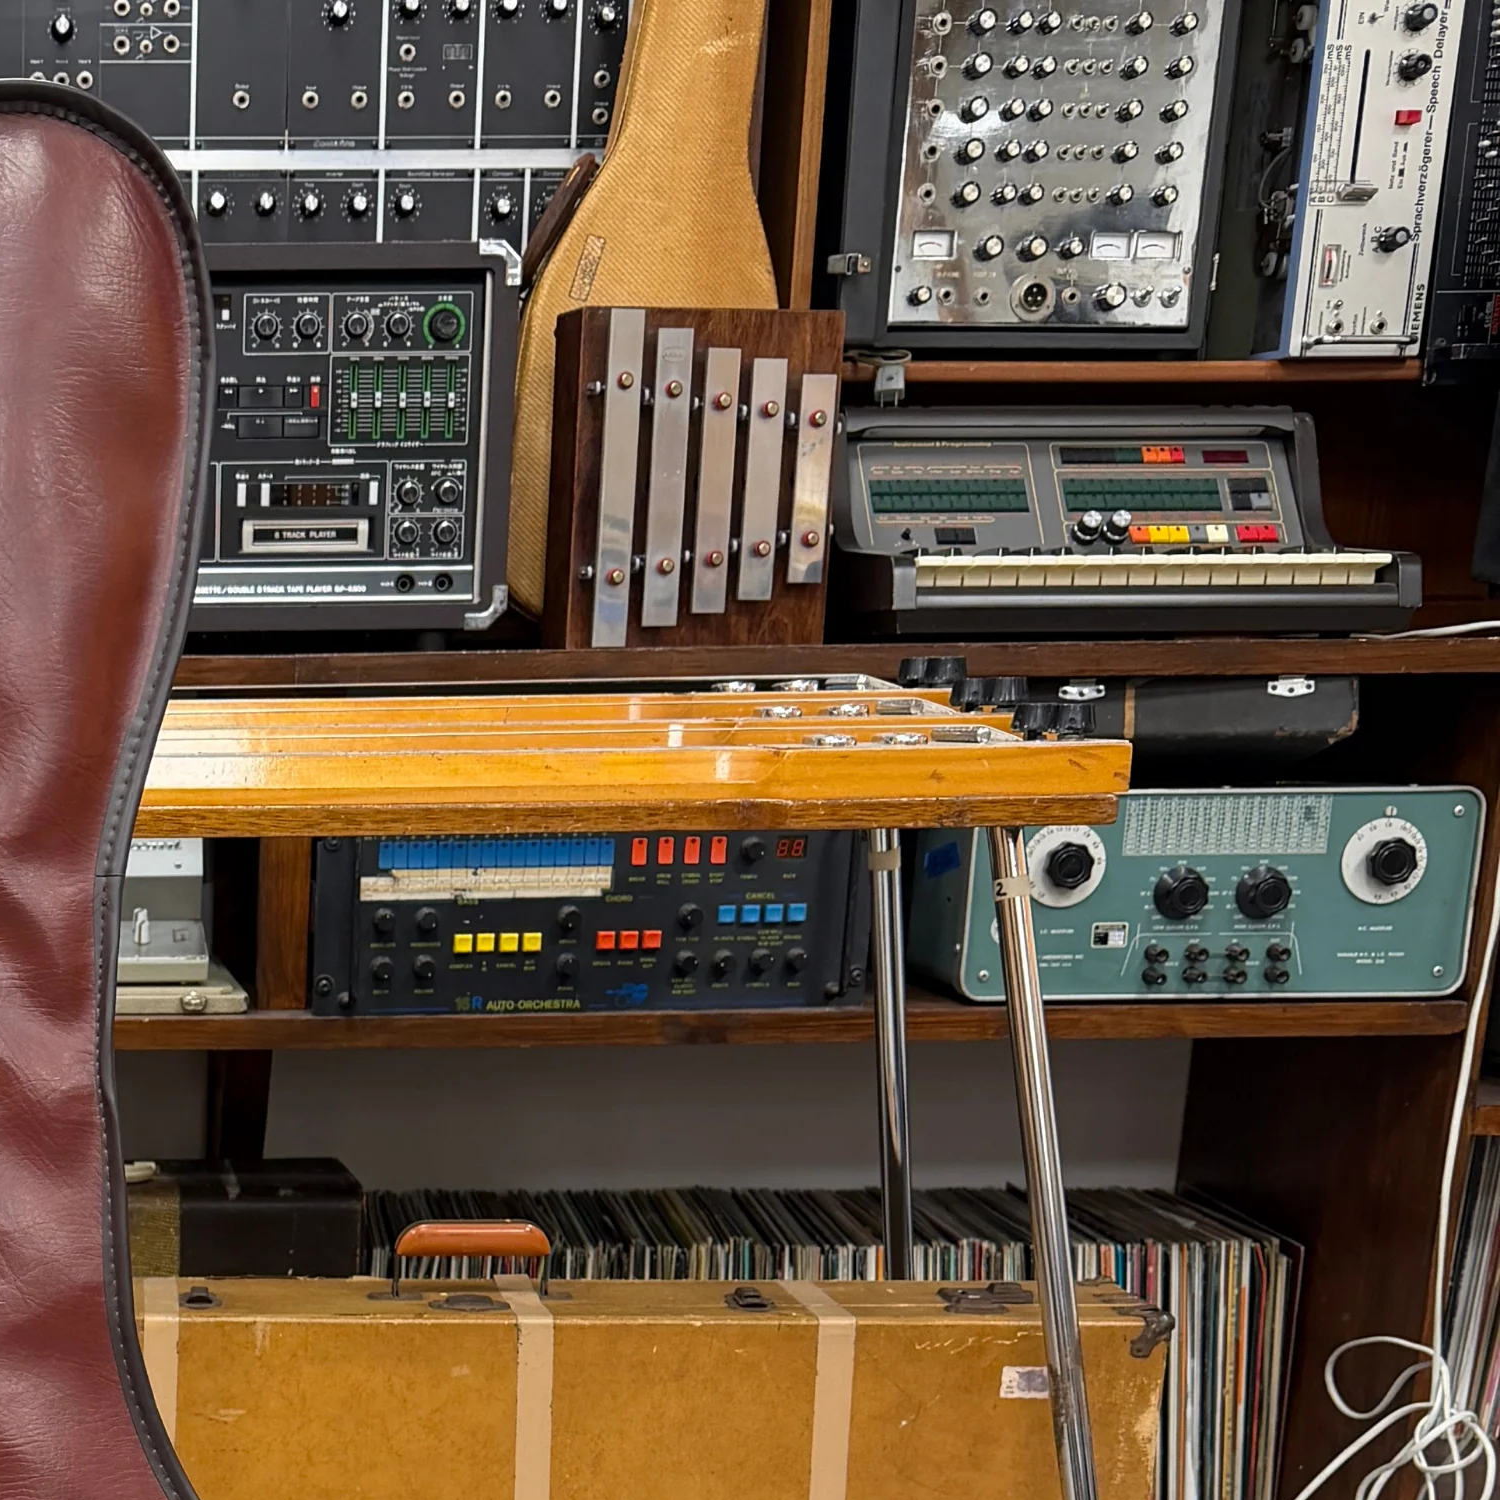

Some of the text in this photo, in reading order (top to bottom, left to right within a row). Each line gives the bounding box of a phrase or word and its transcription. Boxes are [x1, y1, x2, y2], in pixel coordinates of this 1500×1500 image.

[1433, 10, 1449, 59] Delayer
[1326, 44, 1335, 60] mS
[1336, 44, 1344, 60] mS
[1344, 44, 1352, 60] mS
[1412, 283, 1425, 341] IEMENS
[282, 531, 306, 539] TRACK
[309, 530, 337, 538] PLAYER
[745, 892, 776, 900] CANCEL
[995, 883, 1007, 897] 2
